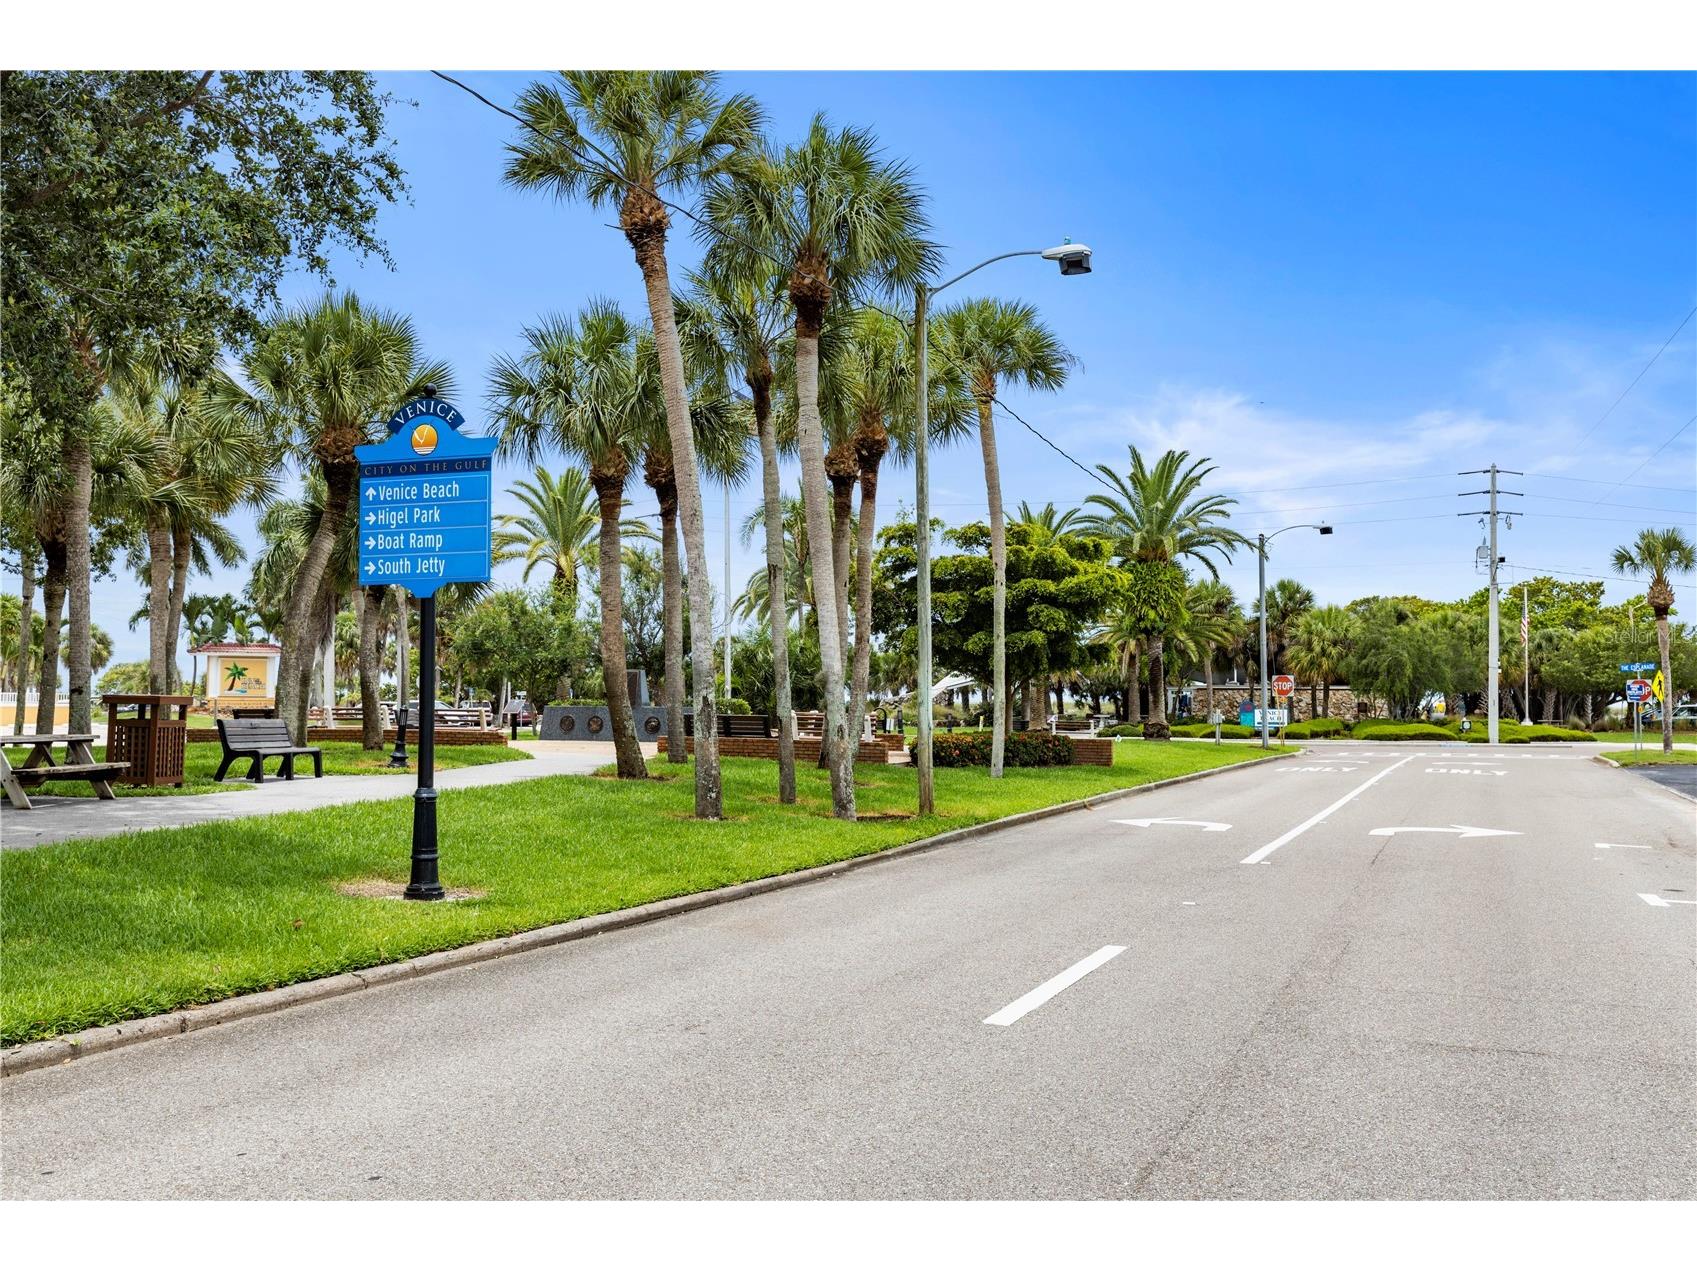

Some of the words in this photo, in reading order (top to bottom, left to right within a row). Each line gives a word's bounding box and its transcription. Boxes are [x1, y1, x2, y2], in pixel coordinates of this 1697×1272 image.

[394, 400, 457, 423] VENICE
[364, 465, 393, 476] CITY
[399, 464, 417, 473] ON
[424, 462, 448, 472] THE
[455, 459, 488, 470] GULF
[378, 482, 418, 501] Venice
[423, 480, 460, 499] Beach
[378, 507, 409, 529] Higel
[413, 505, 441, 524] Park
[377, 532, 405, 550] Boat
[409, 532, 443, 552] Ramp
[377, 557, 411, 575] South
[416, 556, 446, 577] Jetty
[1273, 681, 1293, 690] STOP
[1424, 768, 1509, 776] ONLY
